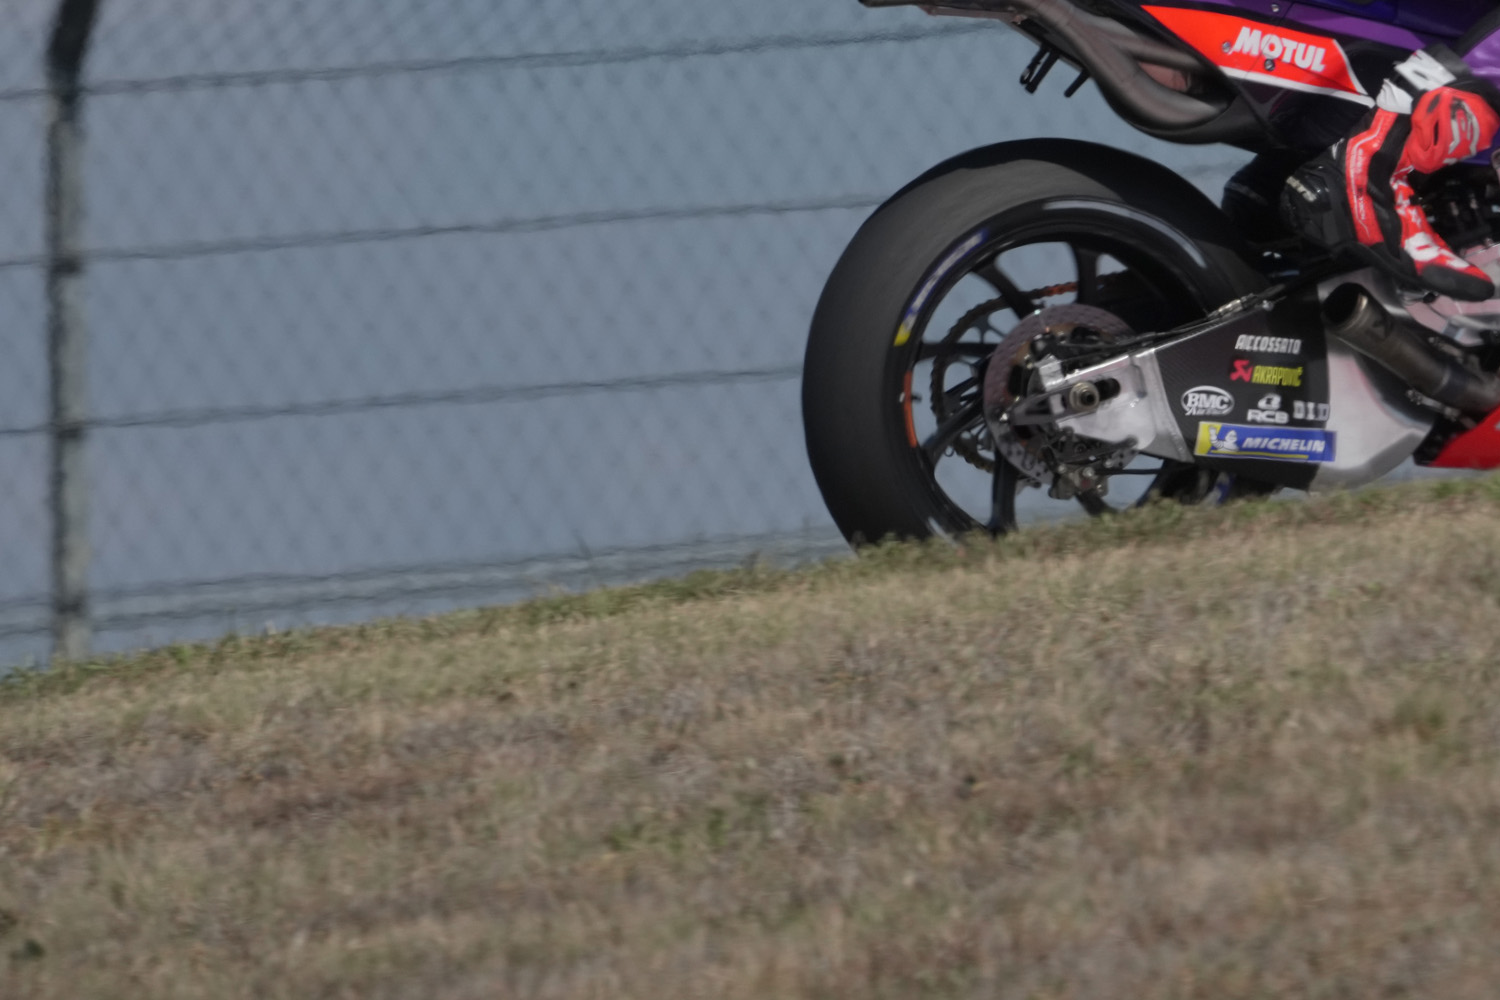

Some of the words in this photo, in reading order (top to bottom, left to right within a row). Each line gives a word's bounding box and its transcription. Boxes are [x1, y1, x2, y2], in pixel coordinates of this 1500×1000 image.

[1228, 26, 1327, 72] MOTUL
[1234, 334, 1302, 355] ACCOSSATO
[1186, 392, 1230, 410] BMC
[1247, 409, 1289, 424] RCB
[1242, 437, 1326, 453] MICHELIN
